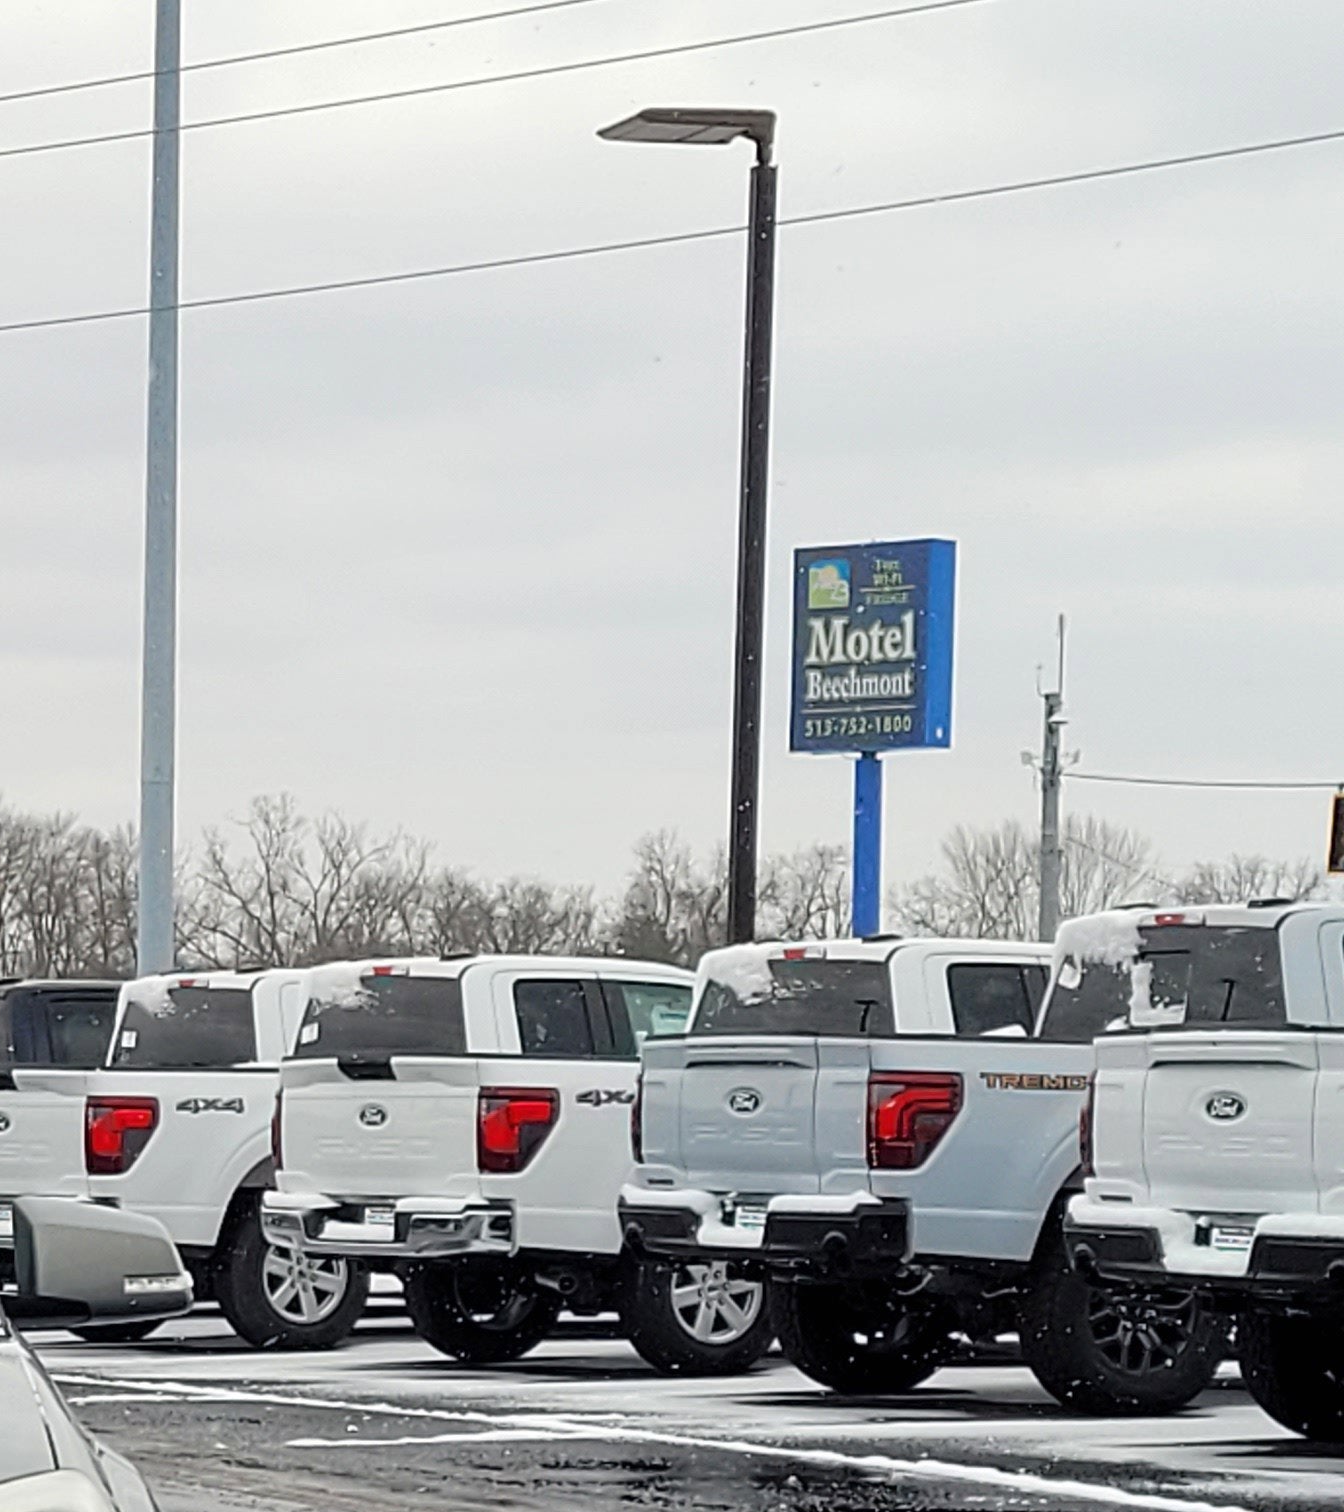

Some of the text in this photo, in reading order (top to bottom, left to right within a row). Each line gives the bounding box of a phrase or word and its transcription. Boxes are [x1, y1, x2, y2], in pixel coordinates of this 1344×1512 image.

[805, 611, 916, 665] Motel
[805, 665, 914, 702] Beechmont
[804, 715, 912, 738] 513-752-1800
[979, 1071, 1088, 1091] TREMO
